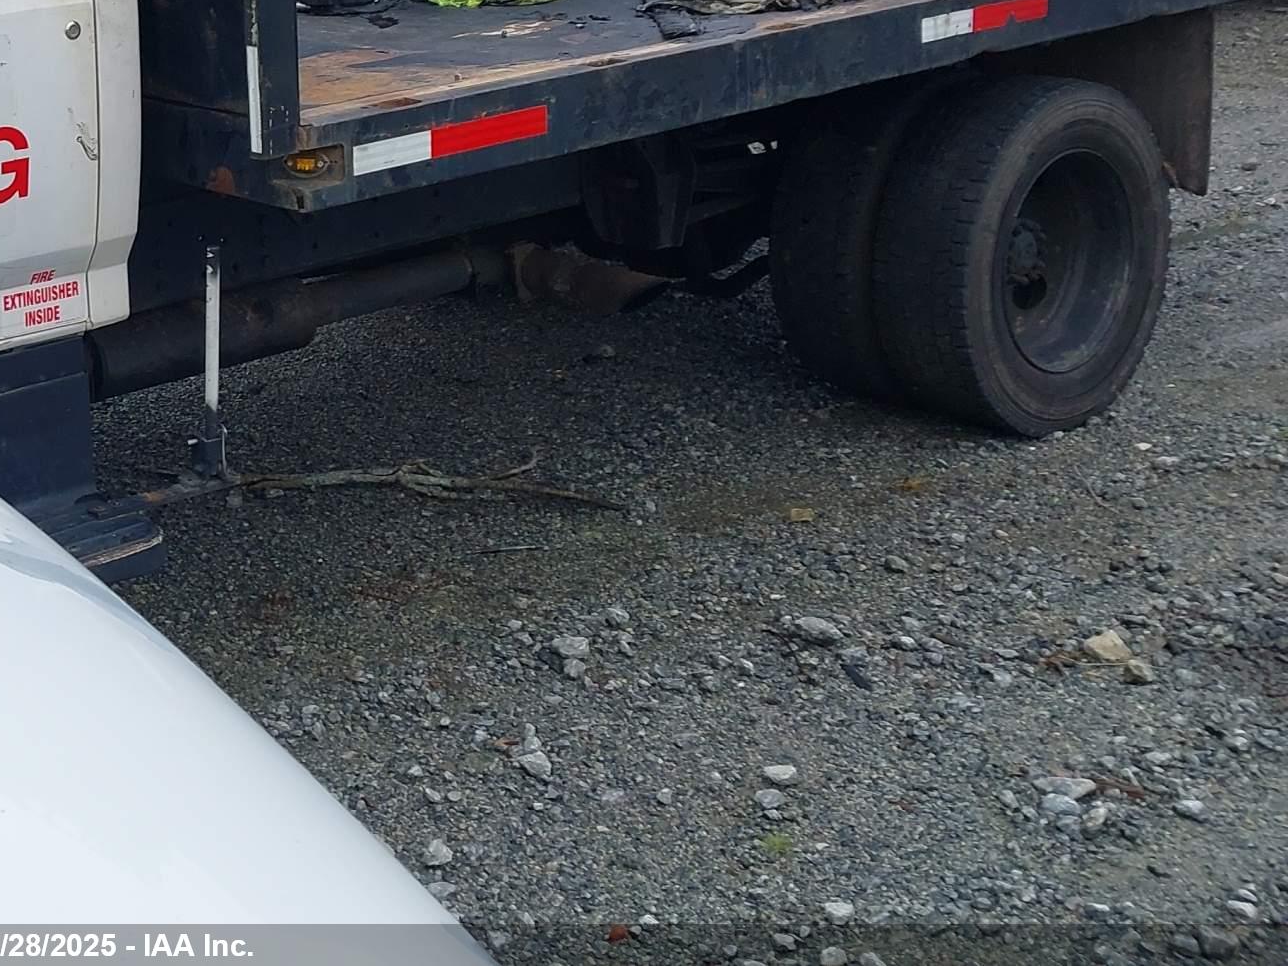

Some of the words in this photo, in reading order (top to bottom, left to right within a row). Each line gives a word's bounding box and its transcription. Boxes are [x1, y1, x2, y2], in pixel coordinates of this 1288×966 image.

[29, 269, 56, 285] FIRE
[3, 281, 79, 311] EXTINGUISHER
[25, 306, 60, 327] INSIDE
